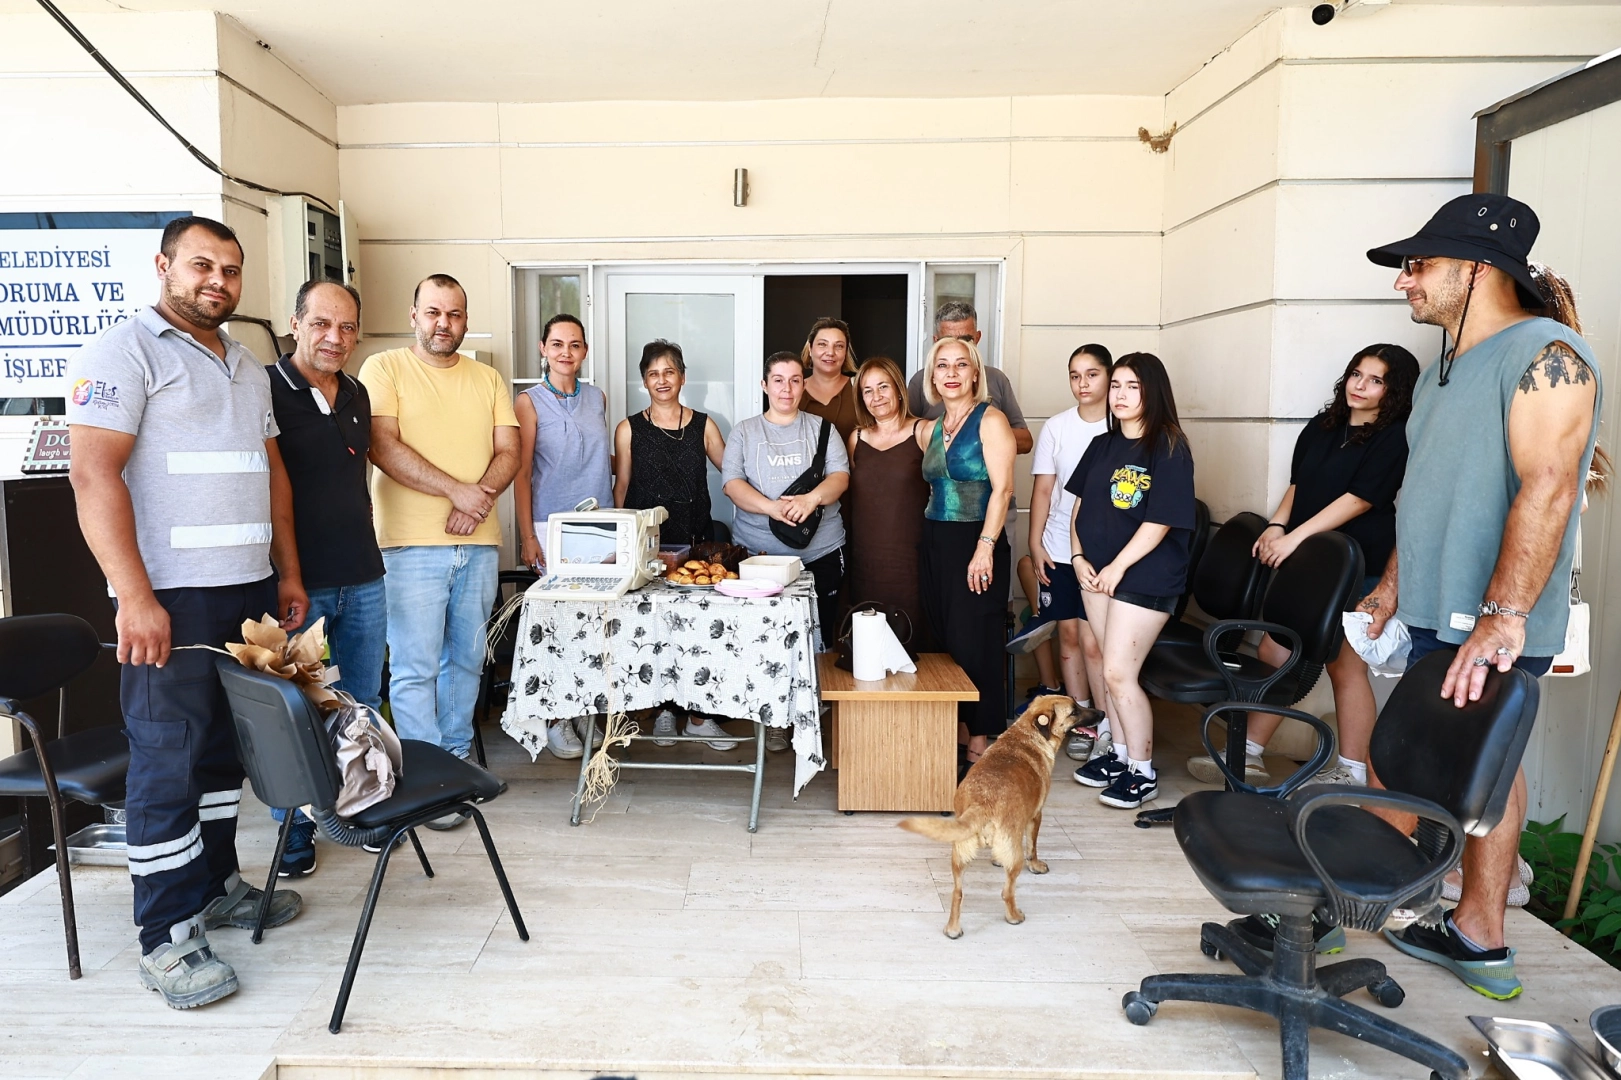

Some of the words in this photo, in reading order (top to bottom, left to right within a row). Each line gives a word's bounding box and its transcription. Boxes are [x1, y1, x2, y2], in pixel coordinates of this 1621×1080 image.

[91, 282, 124, 301] VE
[39, 448, 60, 459] laugh
[767, 453, 802, 467] VANS
[1110, 467, 1152, 491] KAWS
